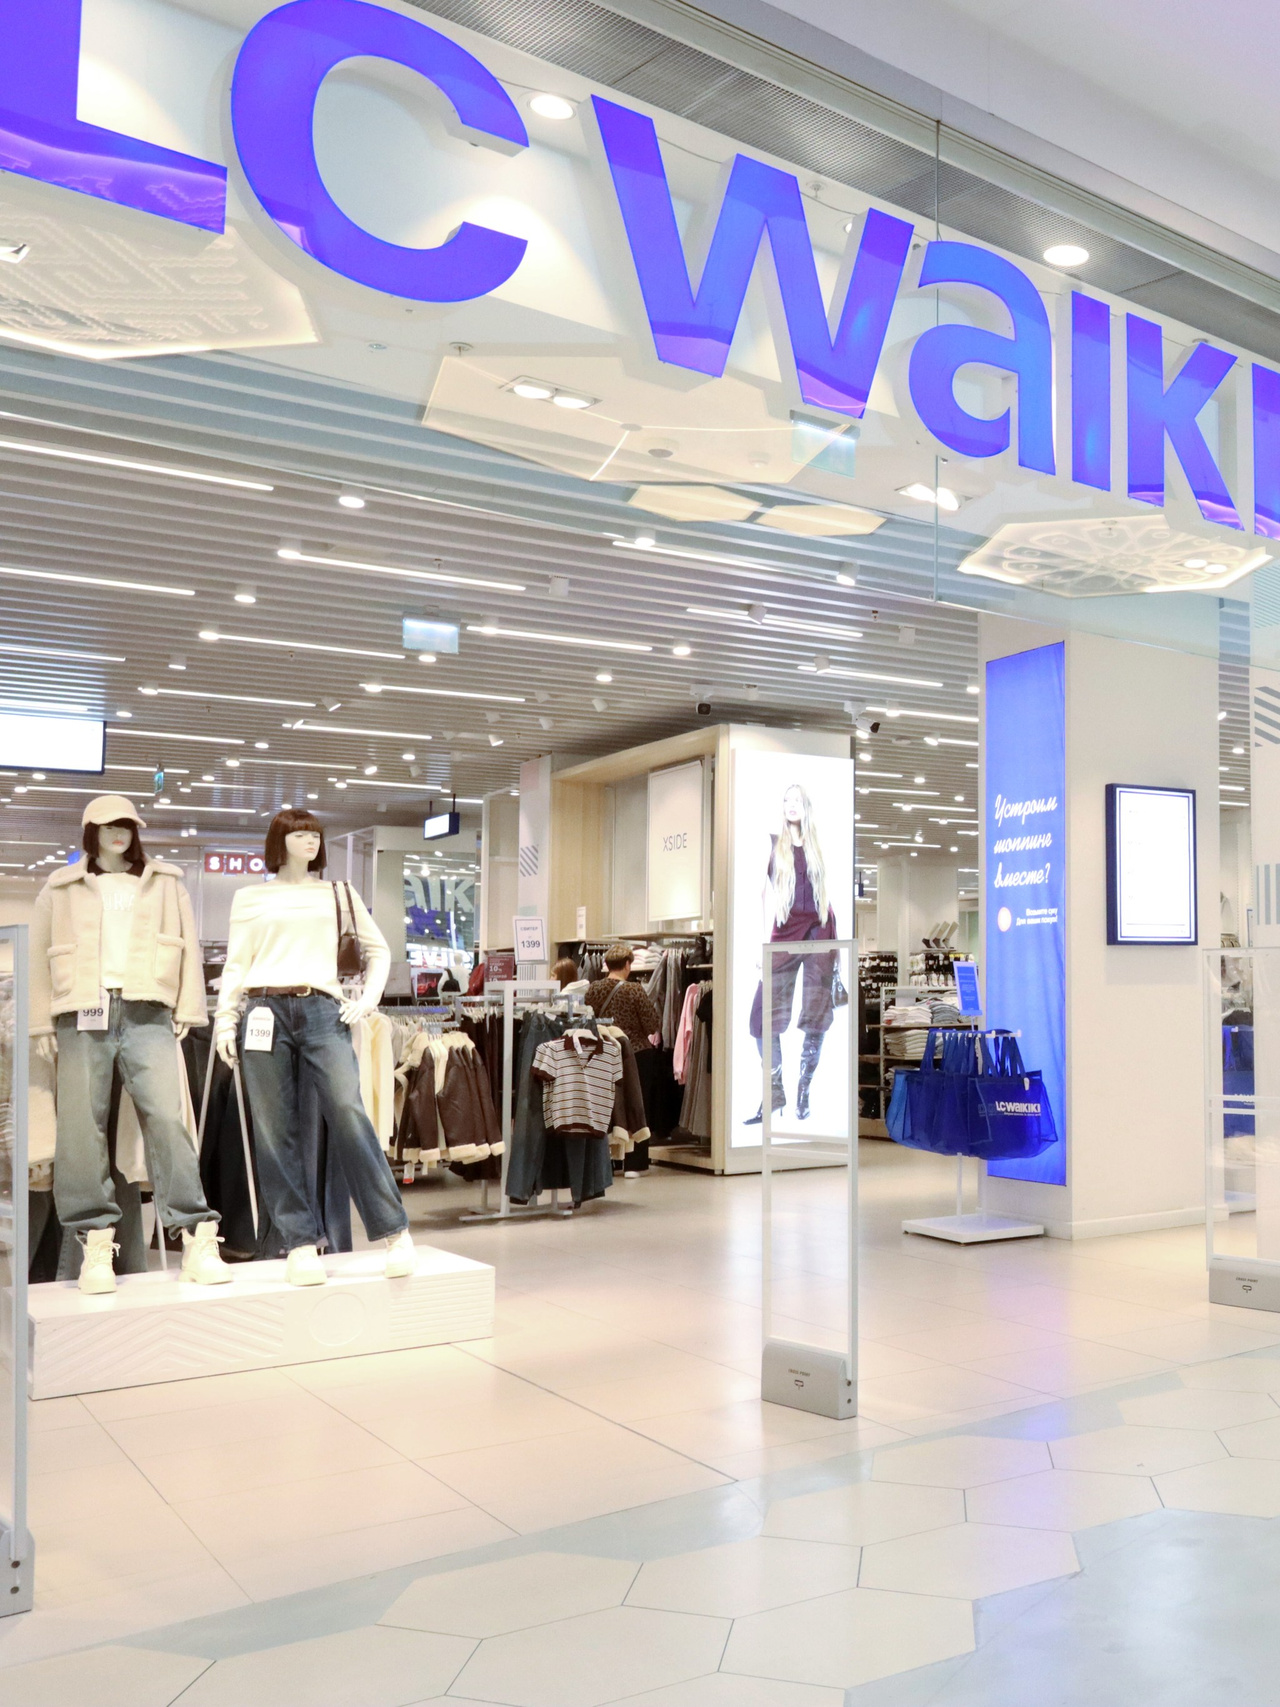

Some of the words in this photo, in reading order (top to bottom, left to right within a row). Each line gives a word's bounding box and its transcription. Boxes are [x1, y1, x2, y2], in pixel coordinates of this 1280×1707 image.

[0, 0, 529, 303] LC
[994, 793, 1058, 828] Устроим
[662, 832, 688, 852] XSIDE
[209, 856, 263, 872] SHO
[993, 861, 1051, 889] вместе?
[521, 940, 541, 949] 1399
[83, 1007, 104, 1017] 999
[249, 1028, 271, 1038] 1399
[995, 1100, 1006, 1112] LC
